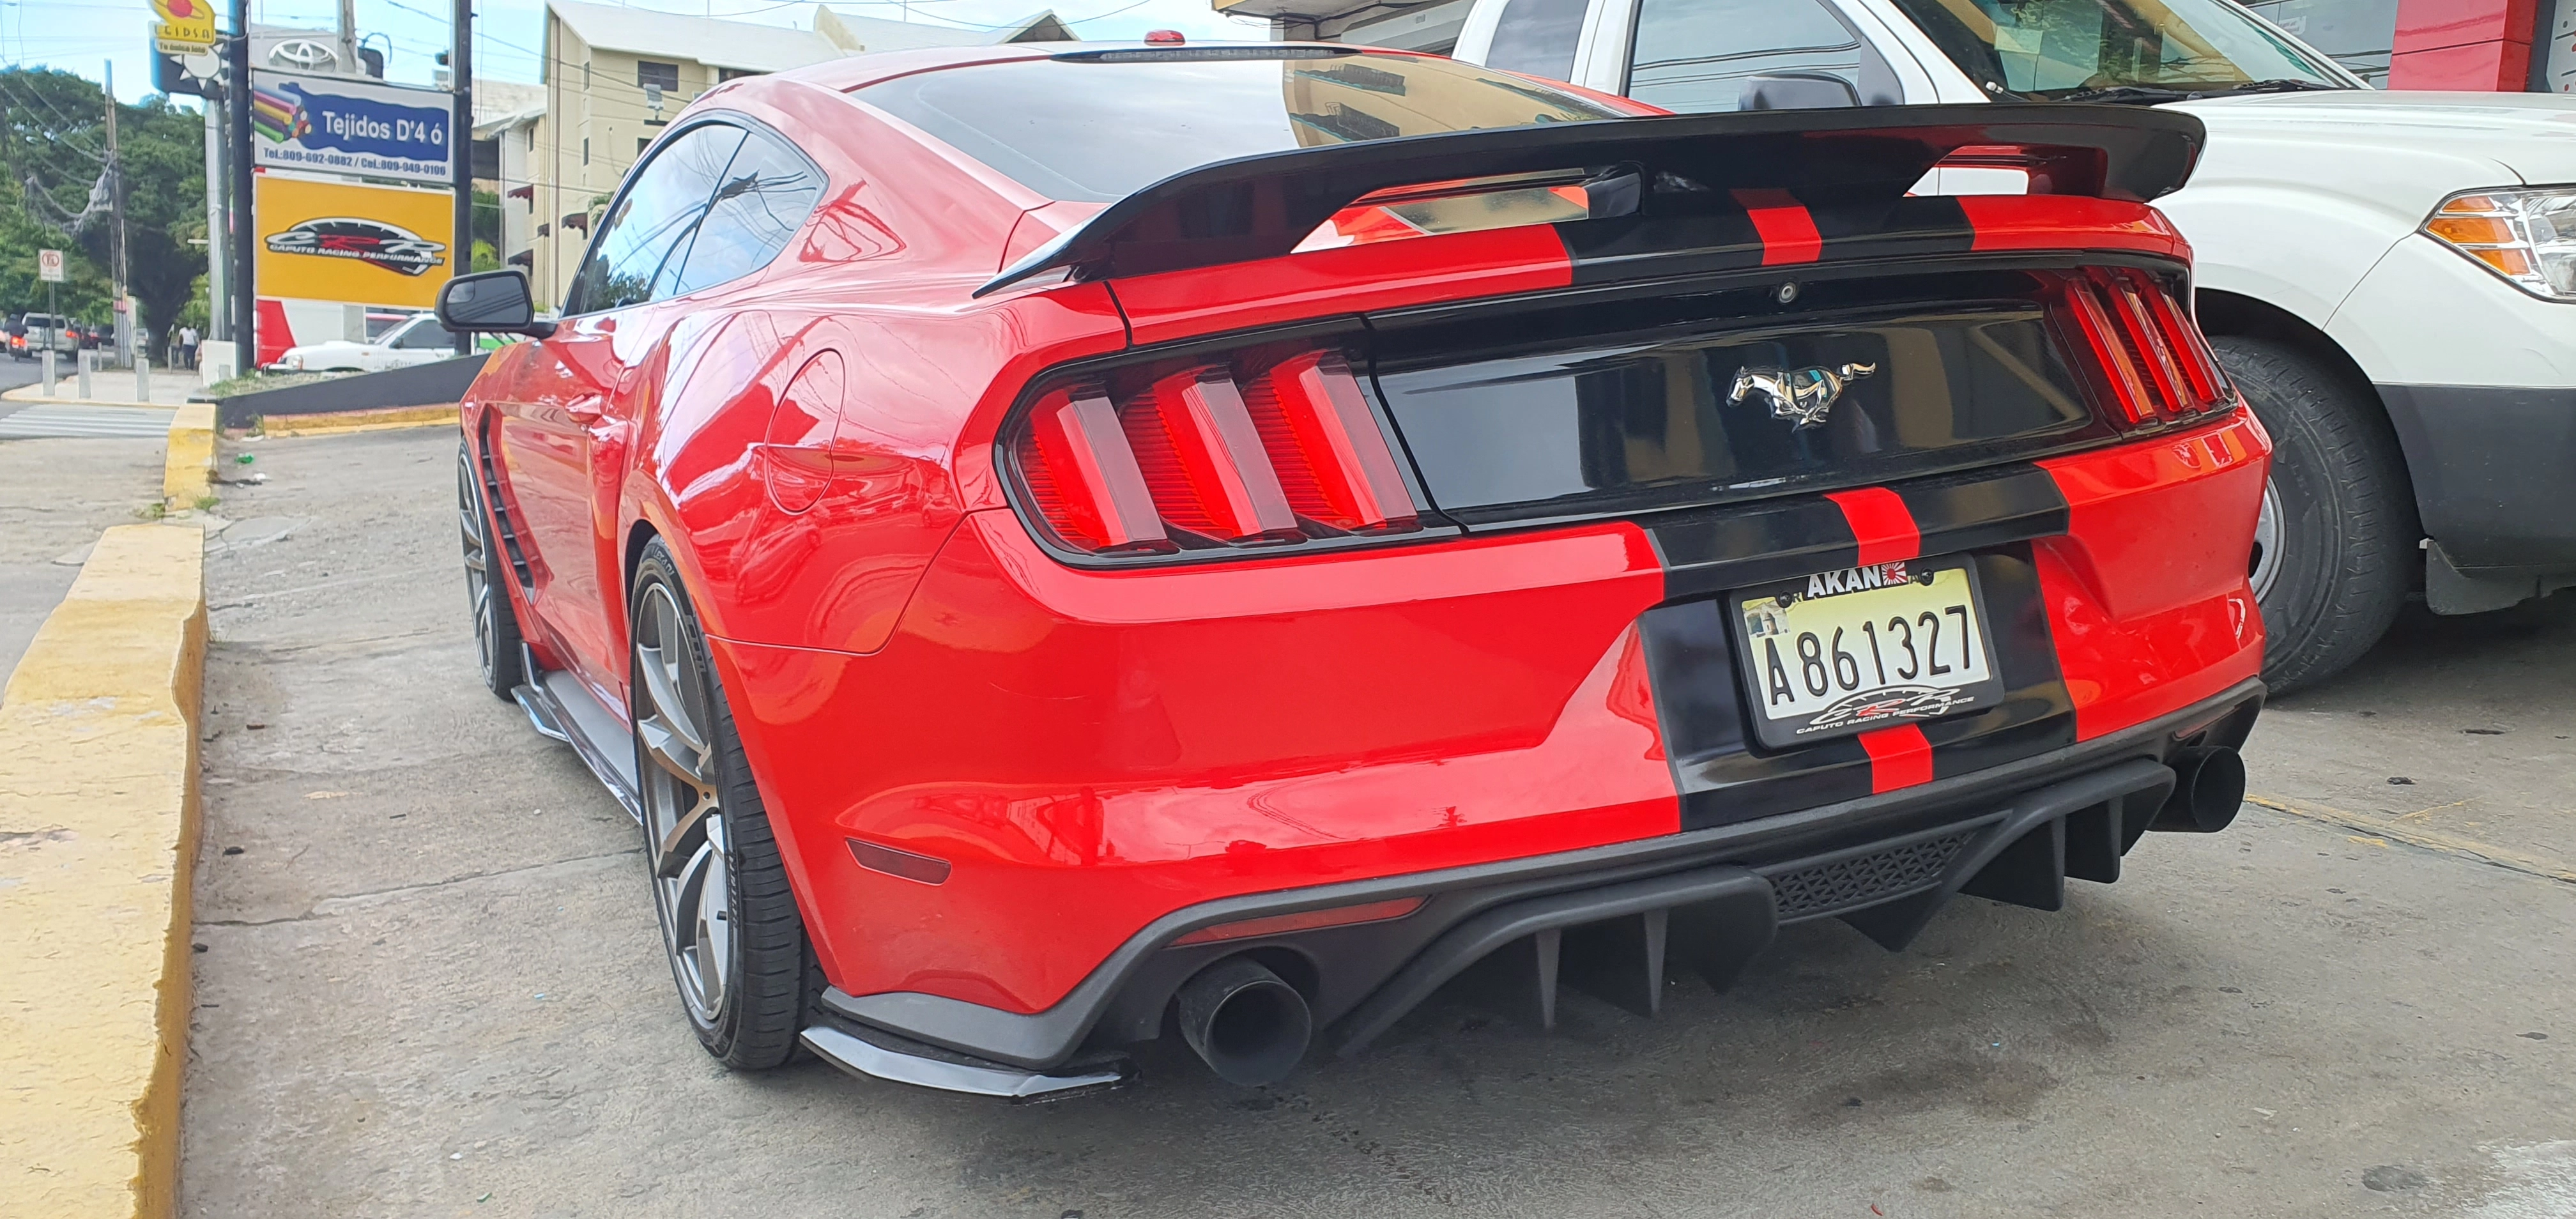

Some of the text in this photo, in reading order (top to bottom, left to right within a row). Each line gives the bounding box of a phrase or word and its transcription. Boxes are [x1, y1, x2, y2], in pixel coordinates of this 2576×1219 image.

[322, 111, 443, 145] Tejidos D'4 ó
[270, 244, 443, 264] CAPUTO RACING PERFORMANCE
[1807, 565, 1882, 598] AKAN
[1765, 604, 1970, 705] A861327
[1796, 696, 1975, 735] CAPUTO RACING PERFORMANCE
